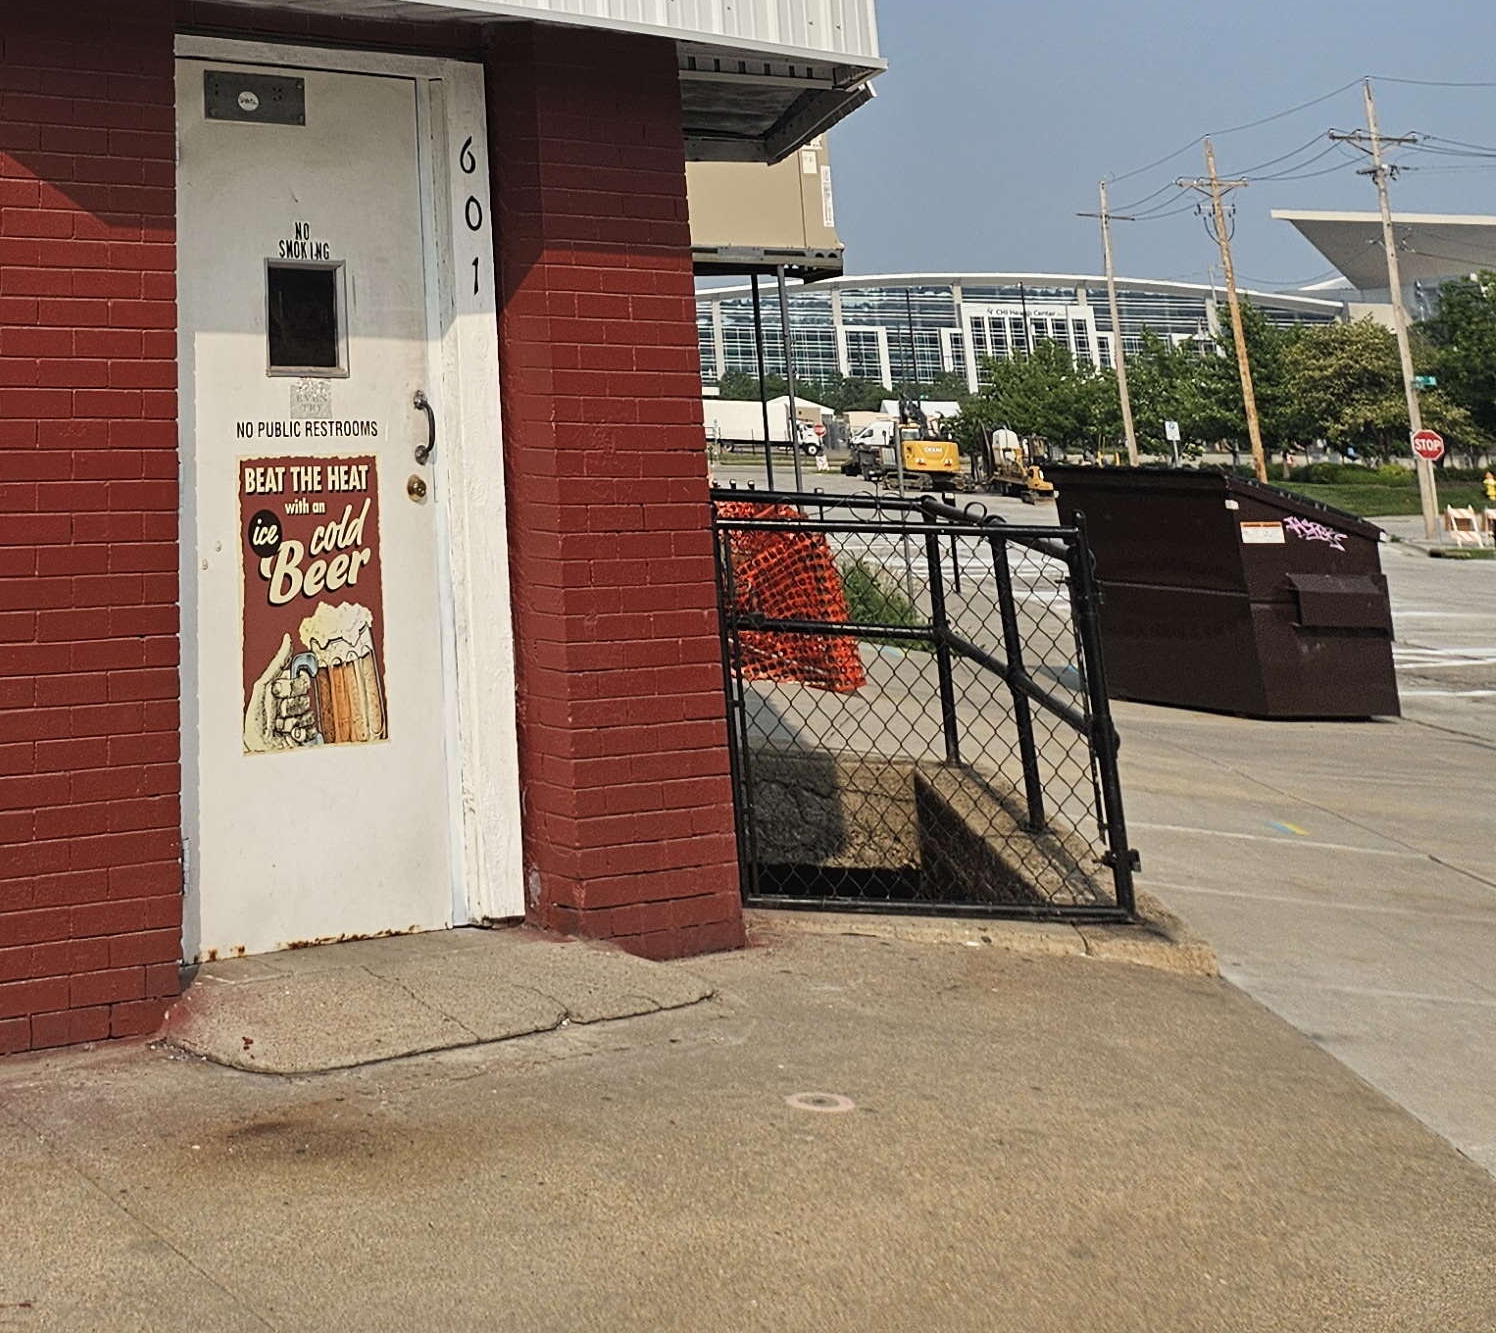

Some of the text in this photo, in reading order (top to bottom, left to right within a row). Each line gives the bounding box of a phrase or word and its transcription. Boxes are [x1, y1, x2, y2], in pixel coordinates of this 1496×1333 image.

[459, 135, 483, 296] 601
[295, 221, 310, 241] NO
[278, 239, 330, 261] SMOKING
[1033, 310, 1056, 318] Center
[236, 419, 379, 439] NO PUBLIC RESTROOMS
[1414, 437, 1442, 452] STOP
[244, 464, 369, 494] BEAT THE HEAT
[284, 497, 326, 515] with an
[252, 497, 371, 556] ice cold
[260, 539, 371, 605] Beer
